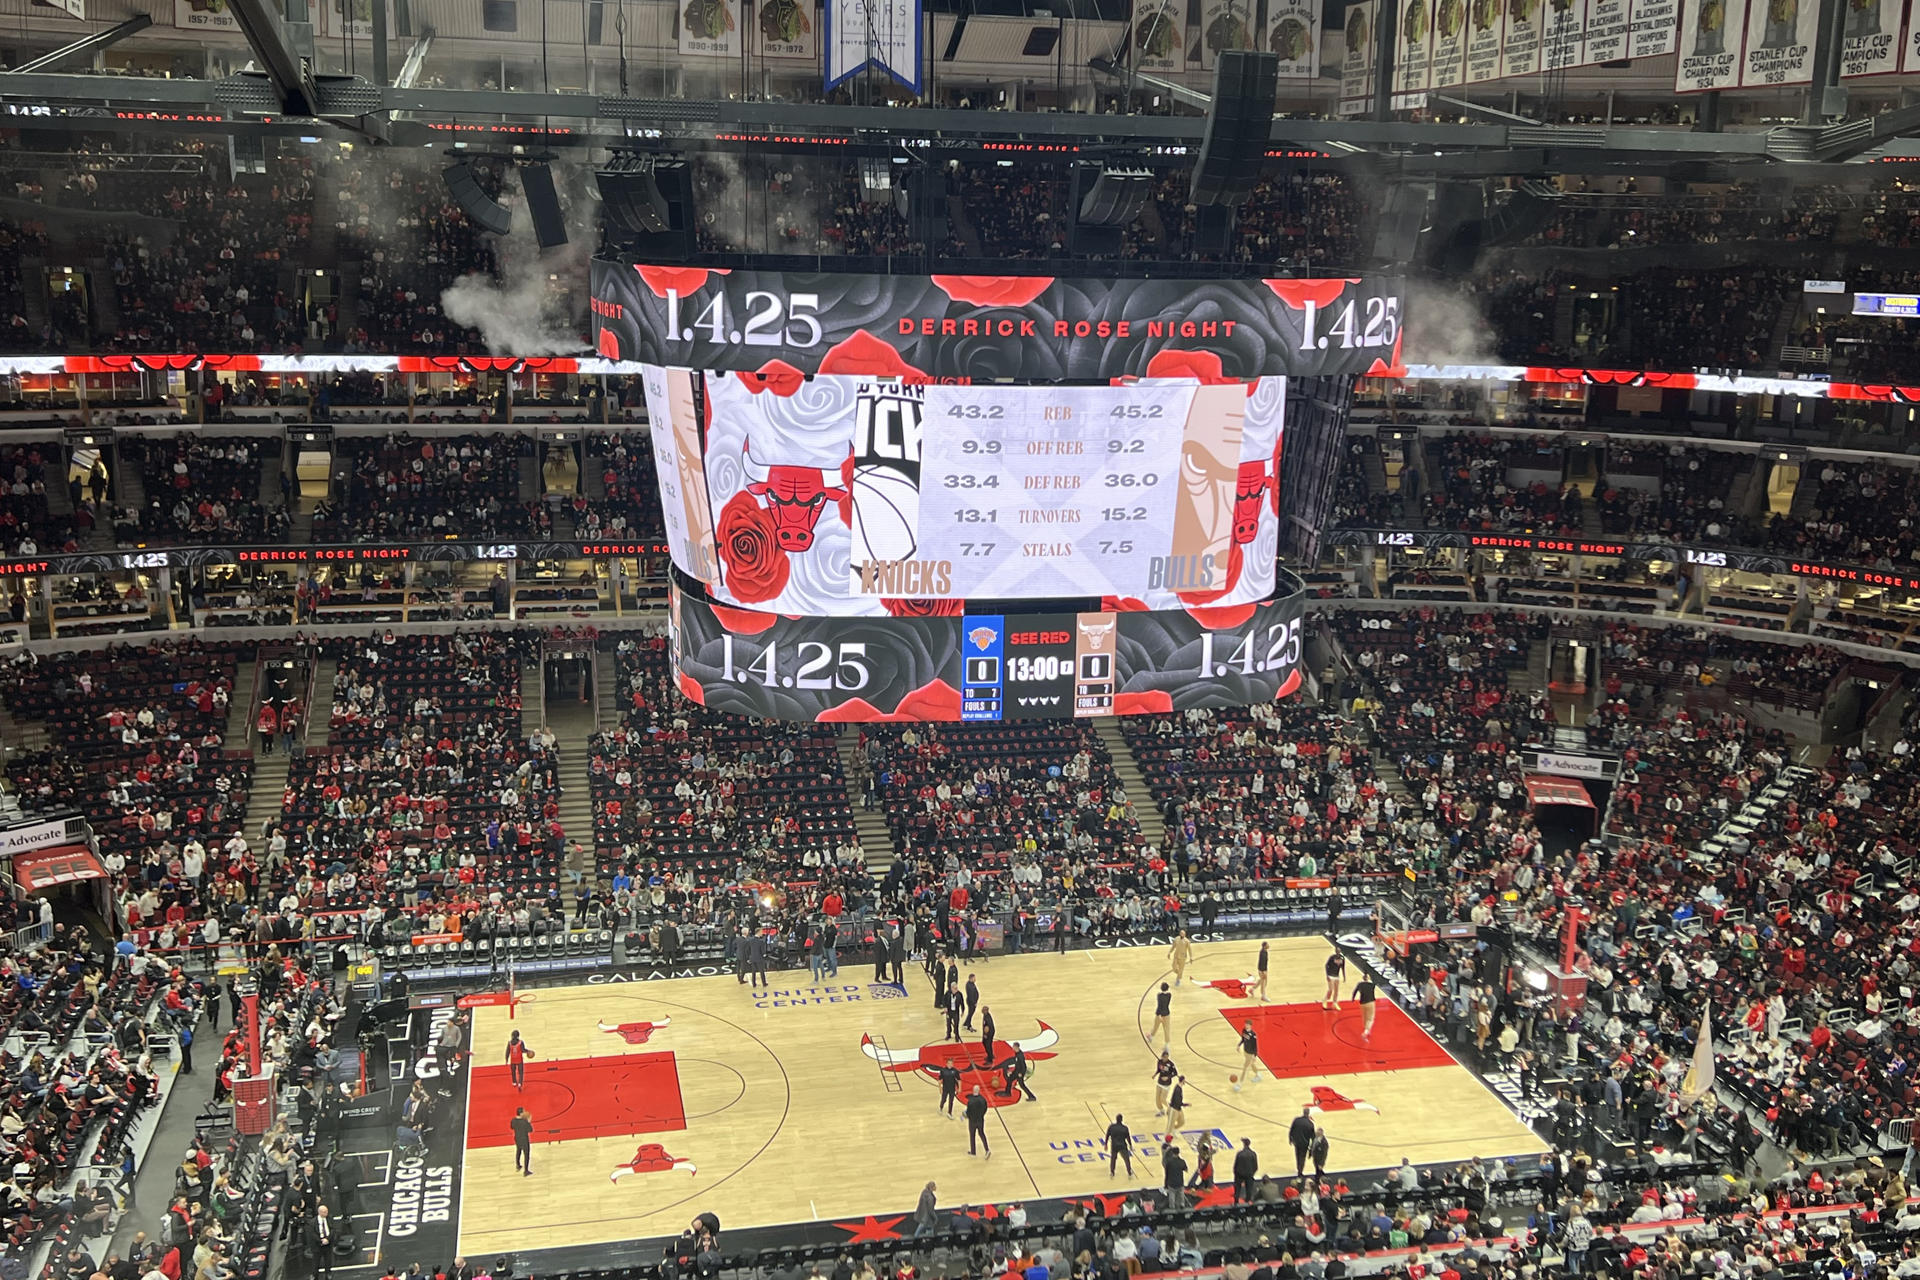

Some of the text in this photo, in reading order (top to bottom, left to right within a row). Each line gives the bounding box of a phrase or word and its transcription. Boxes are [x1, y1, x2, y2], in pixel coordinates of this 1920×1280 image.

[841, 2, 906, 16] YEARS
[1636, 4, 1673, 20] BLACKHAWKS
[188, 15, 233, 26] 1957-1967
[1636, 30, 1668, 44] CHAMPIONS
[1845, 34, 1893, 50] NLEY CUP
[1683, 54, 1735, 69] STANLEY CUP
[1749, 46, 1808, 63] STANLEY CUP
[1842, 47, 1888, 62] AMPIONS
[1685, 66, 1730, 80] CHAMPIONS
[1751, 58, 1802, 74] CHAMPIONS
[1846, 62, 1869, 74] 1961
[1765, 70, 1785, 83] 1938
[665, 288, 823, 348] 1.4.25
[1299, 295, 1398, 351] 1.4.25
[899, 317, 1237, 339] DERRICK ROSE NIGHT
[947, 404, 1164, 421] 43.2 REB 45.2
[962, 440, 1145, 456] 9.9 OFF REB 9.2
[943, 473, 1159, 490] 33.4 DEF REB 36.0
[953, 507, 1148, 524] 13.1 TURNOVERS 15.2
[476, 545, 517, 559] 1.4.25
[582, 545, 646, 555] DERRICK
[959, 540, 1134, 558] 7.7 STEALS 7.5
[1471, 536, 1625, 555] DERRICK ROSE NIGHT
[121, 553, 169, 569] 1.4.25
[239, 549, 410, 562] DERRICK ROSE NIGHT
[860, 553, 1215, 595] KNICKS BULLS
[1791, 563, 1857, 580] DERRICK
[1863, 573, 1903, 587] ROSE
[1010, 632, 1038, 645] SEE
[1039, 631, 1071, 644] RED
[1198, 617, 1301, 679] 1.4.25
[720, 633, 870, 690] 1.4.25
[977, 656, 1100, 682] 0 13:00 0
[965, 688, 997, 698] TO 7
[1078, 684, 1109, 695] TO 7
[964, 700, 997, 712] FOULS 0
[1078, 698, 1098, 708] FOULS
[7, 829, 61, 849] Advocate
[29, 860, 89, 880] SEE
[587, 964, 737, 984] CALAMOS
[752, 985, 860, 999] UNITED
[755, 995, 862, 1009] CENTER
[388, 1155, 425, 1237] CHICAGO
[422, 1165, 453, 1223] BULLS
